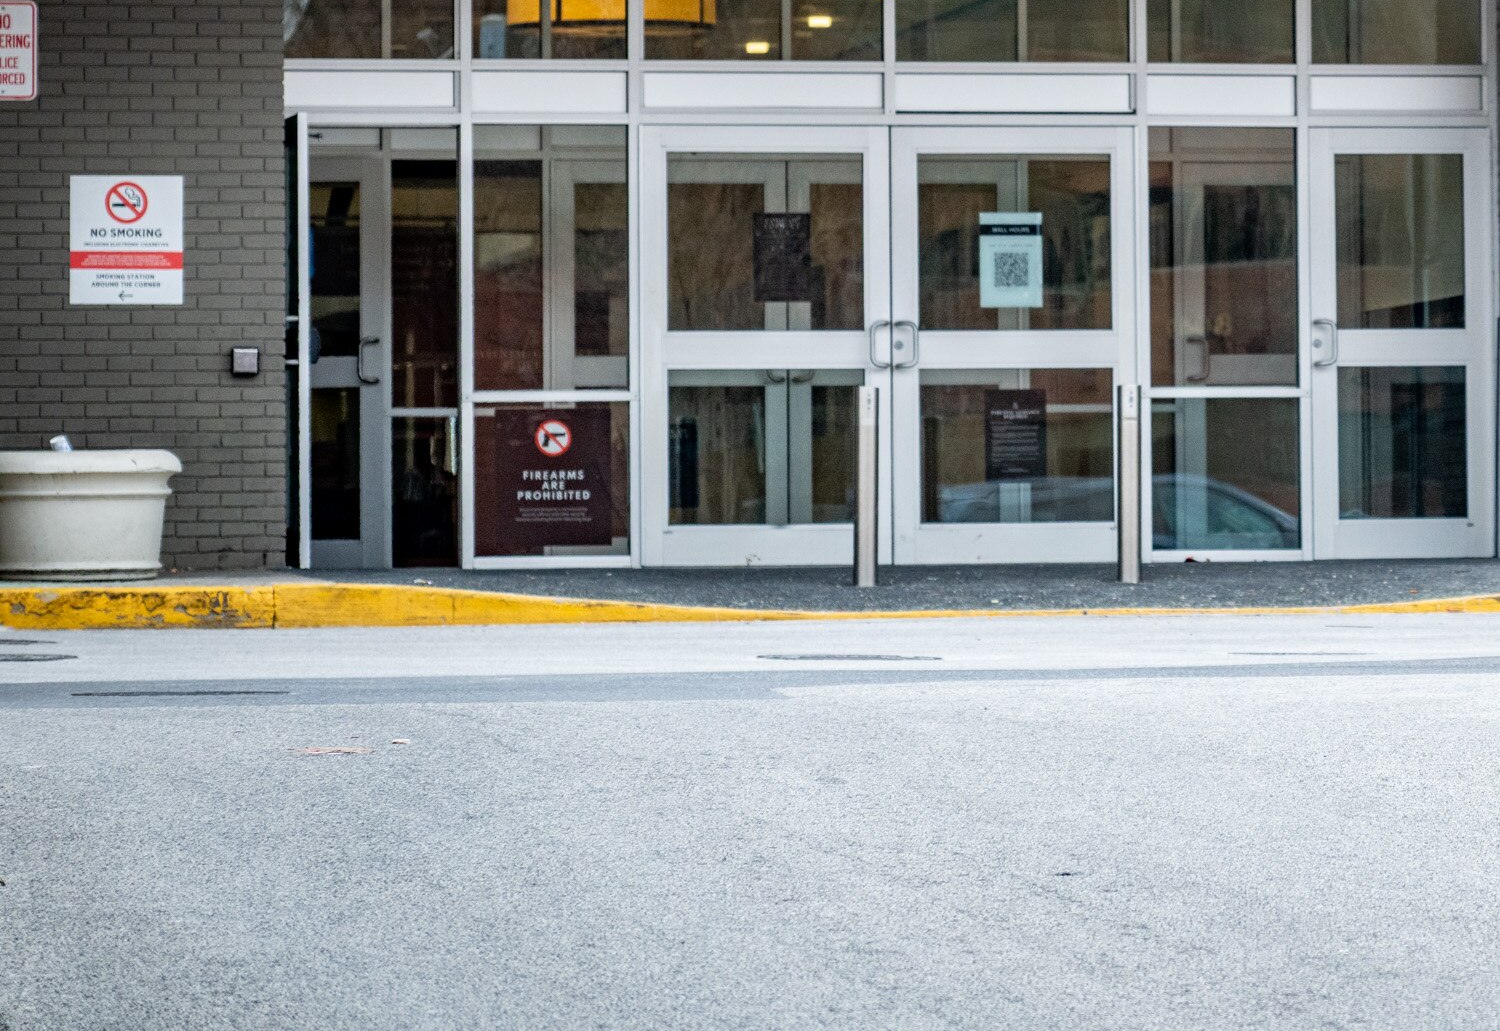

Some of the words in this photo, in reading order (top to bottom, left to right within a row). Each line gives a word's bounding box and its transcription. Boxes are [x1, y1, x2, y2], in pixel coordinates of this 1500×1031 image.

[0, 14, 11, 29] O
[90, 228, 107, 238] NO
[110, 228, 162, 238] SMOKING
[522, 470, 585, 480] FIREARMS
[541, 481, 566, 490] ARE
[516, 490, 592, 501] PROHIBITED
